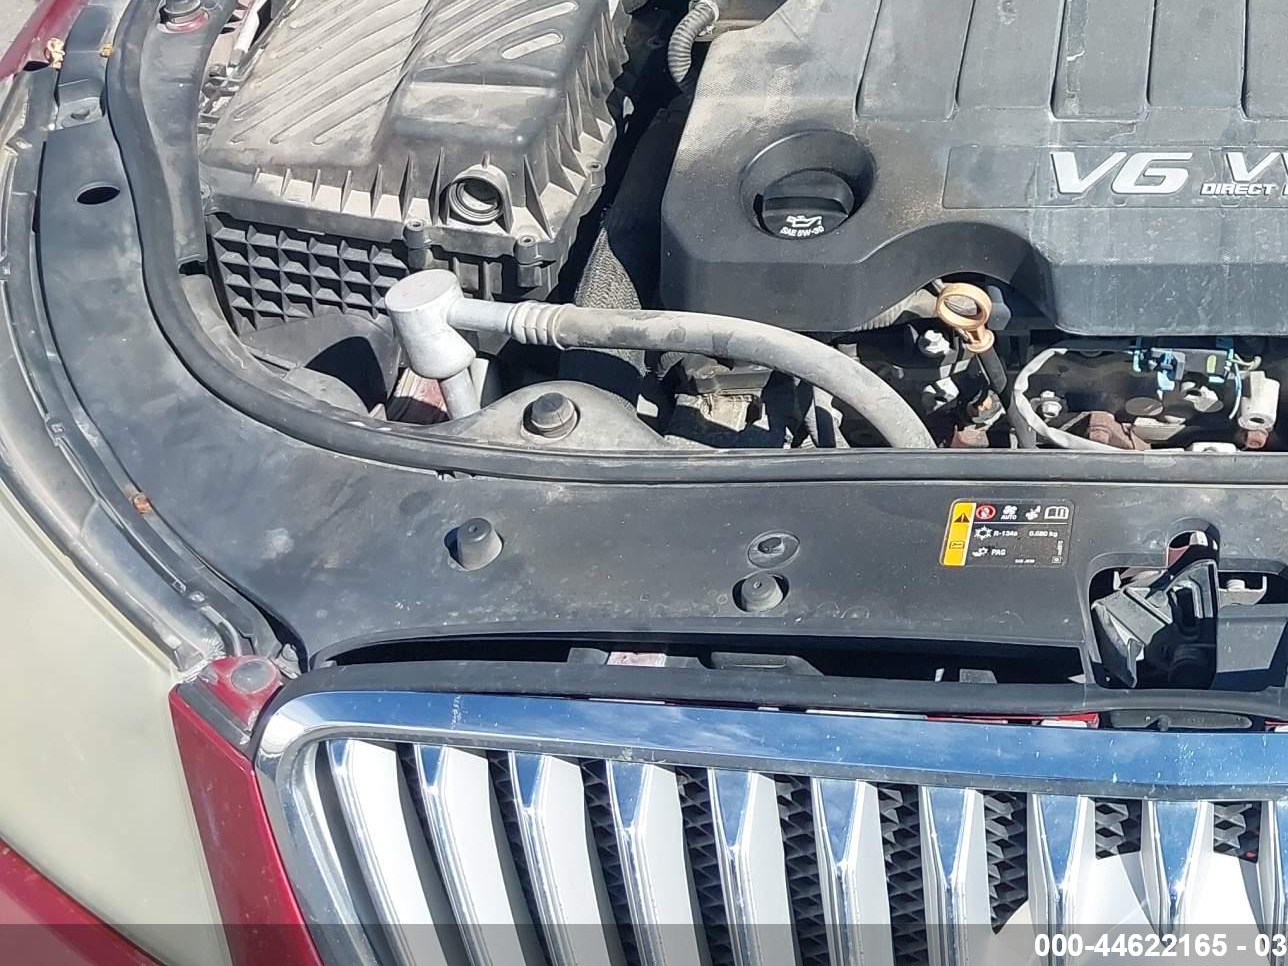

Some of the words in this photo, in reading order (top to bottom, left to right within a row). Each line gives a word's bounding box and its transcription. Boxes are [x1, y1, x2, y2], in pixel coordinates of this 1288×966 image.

[1050, 152, 1193, 195] V6
[1200, 183, 1276, 196] DIRECT
[780, 226, 797, 237] SAE
[1049, 530, 1058, 538] kg
